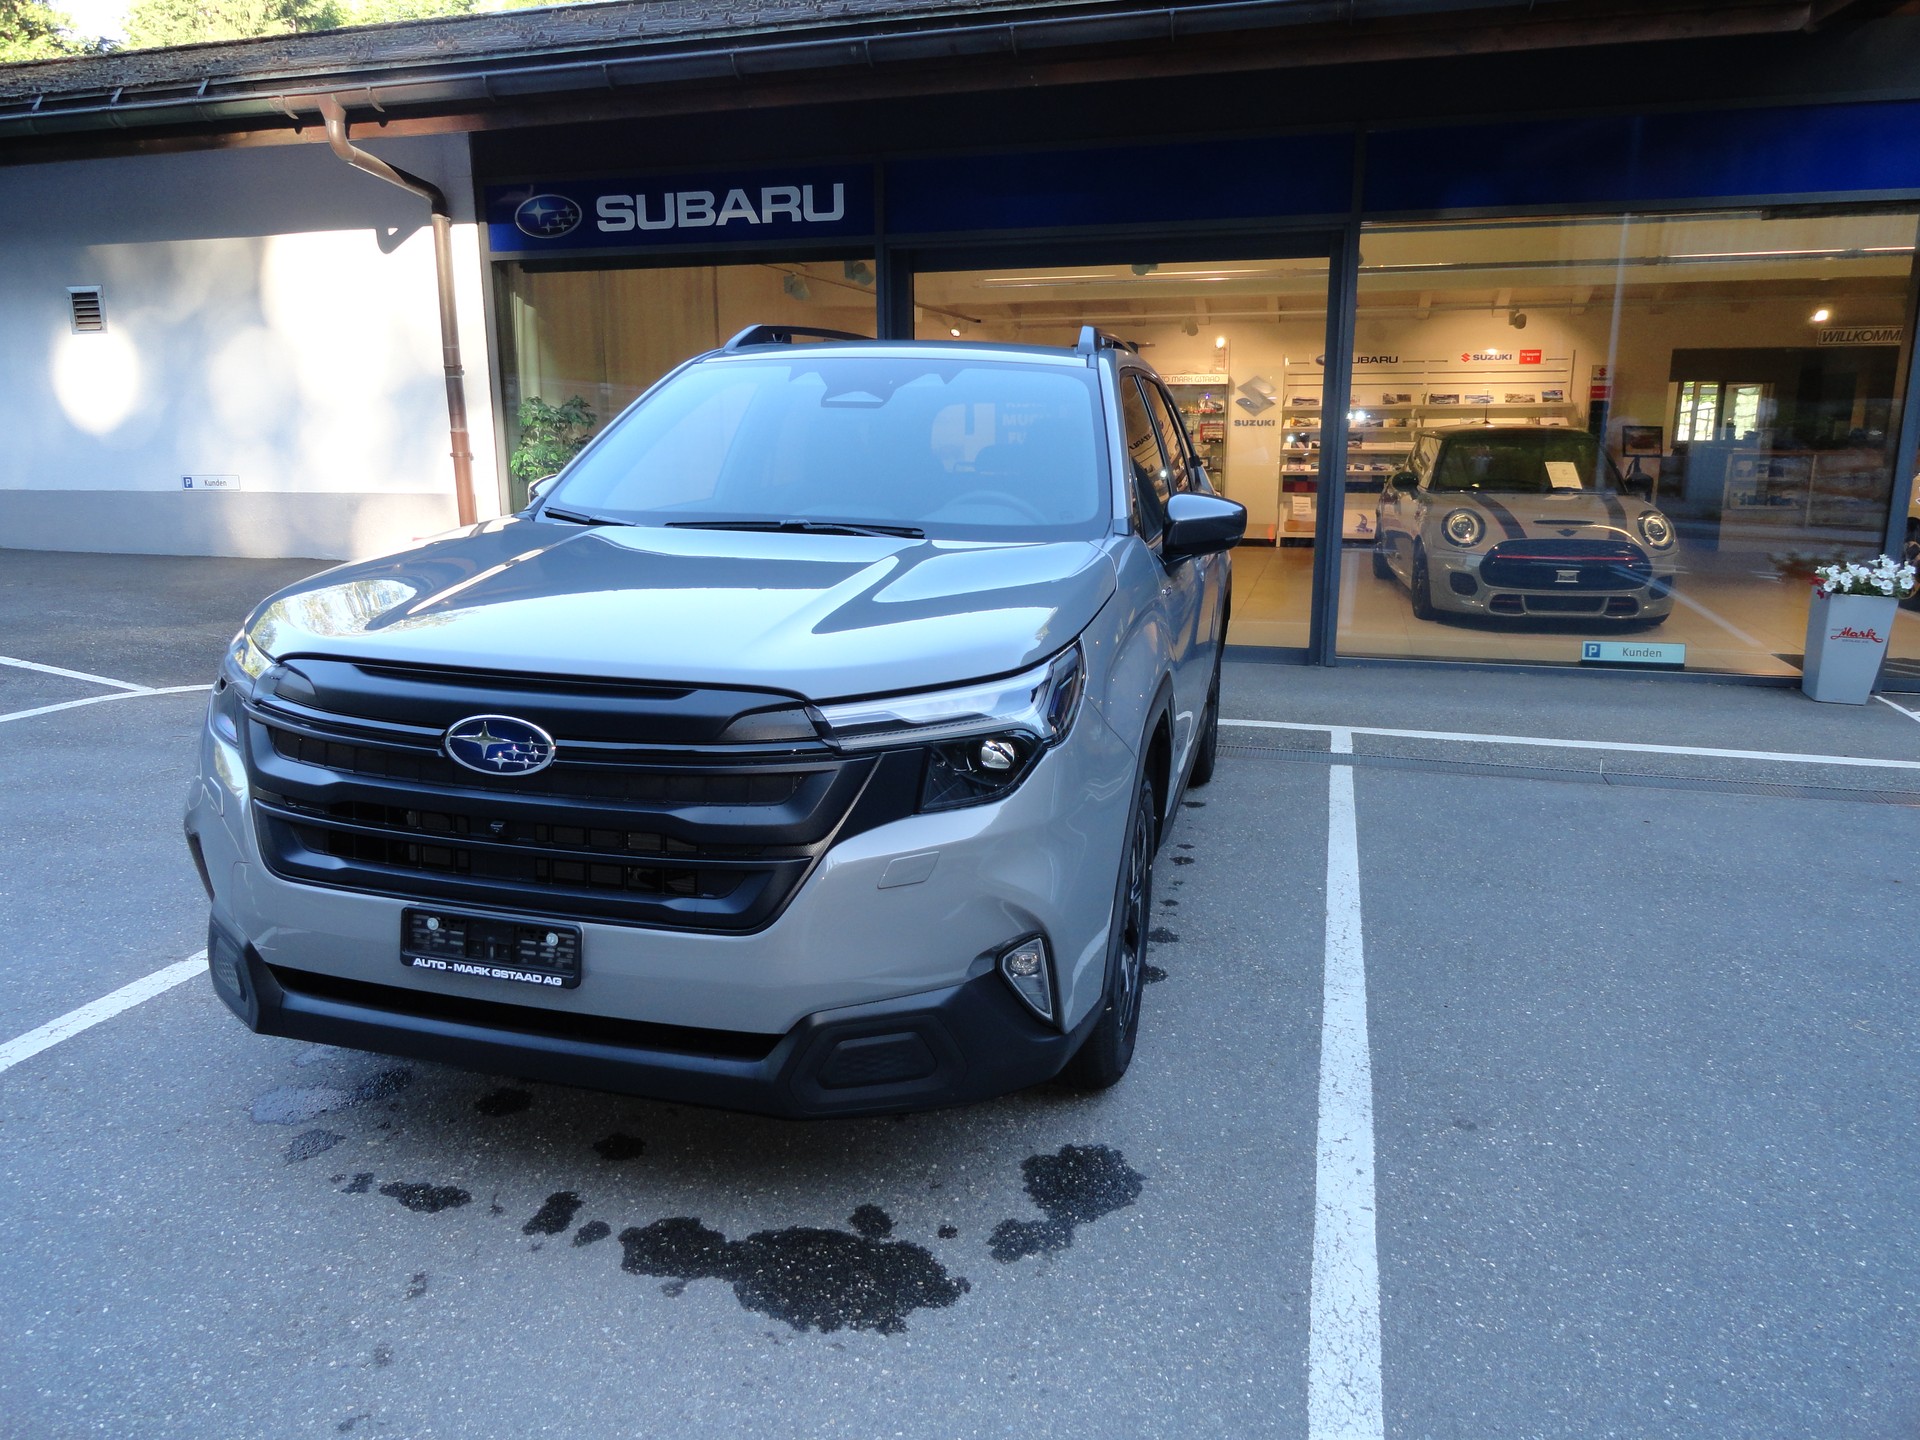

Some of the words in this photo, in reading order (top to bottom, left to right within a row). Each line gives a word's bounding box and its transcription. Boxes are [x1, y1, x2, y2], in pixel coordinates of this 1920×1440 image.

[596, 183, 844, 232] SUBARU
[1822, 330, 1902, 342] WILLKOMM
[1352, 356, 1398, 364] UBARU
[1831, 627, 1883, 643] Mark
[1588, 645, 1597, 656] P
[1622, 647, 1662, 658] Kunden
[413, 958, 447, 970] AUTO
[453, 964, 491, 977] MARK
[492, 970, 542, 984] GSTAAD
[543, 977, 563, 986] AG
